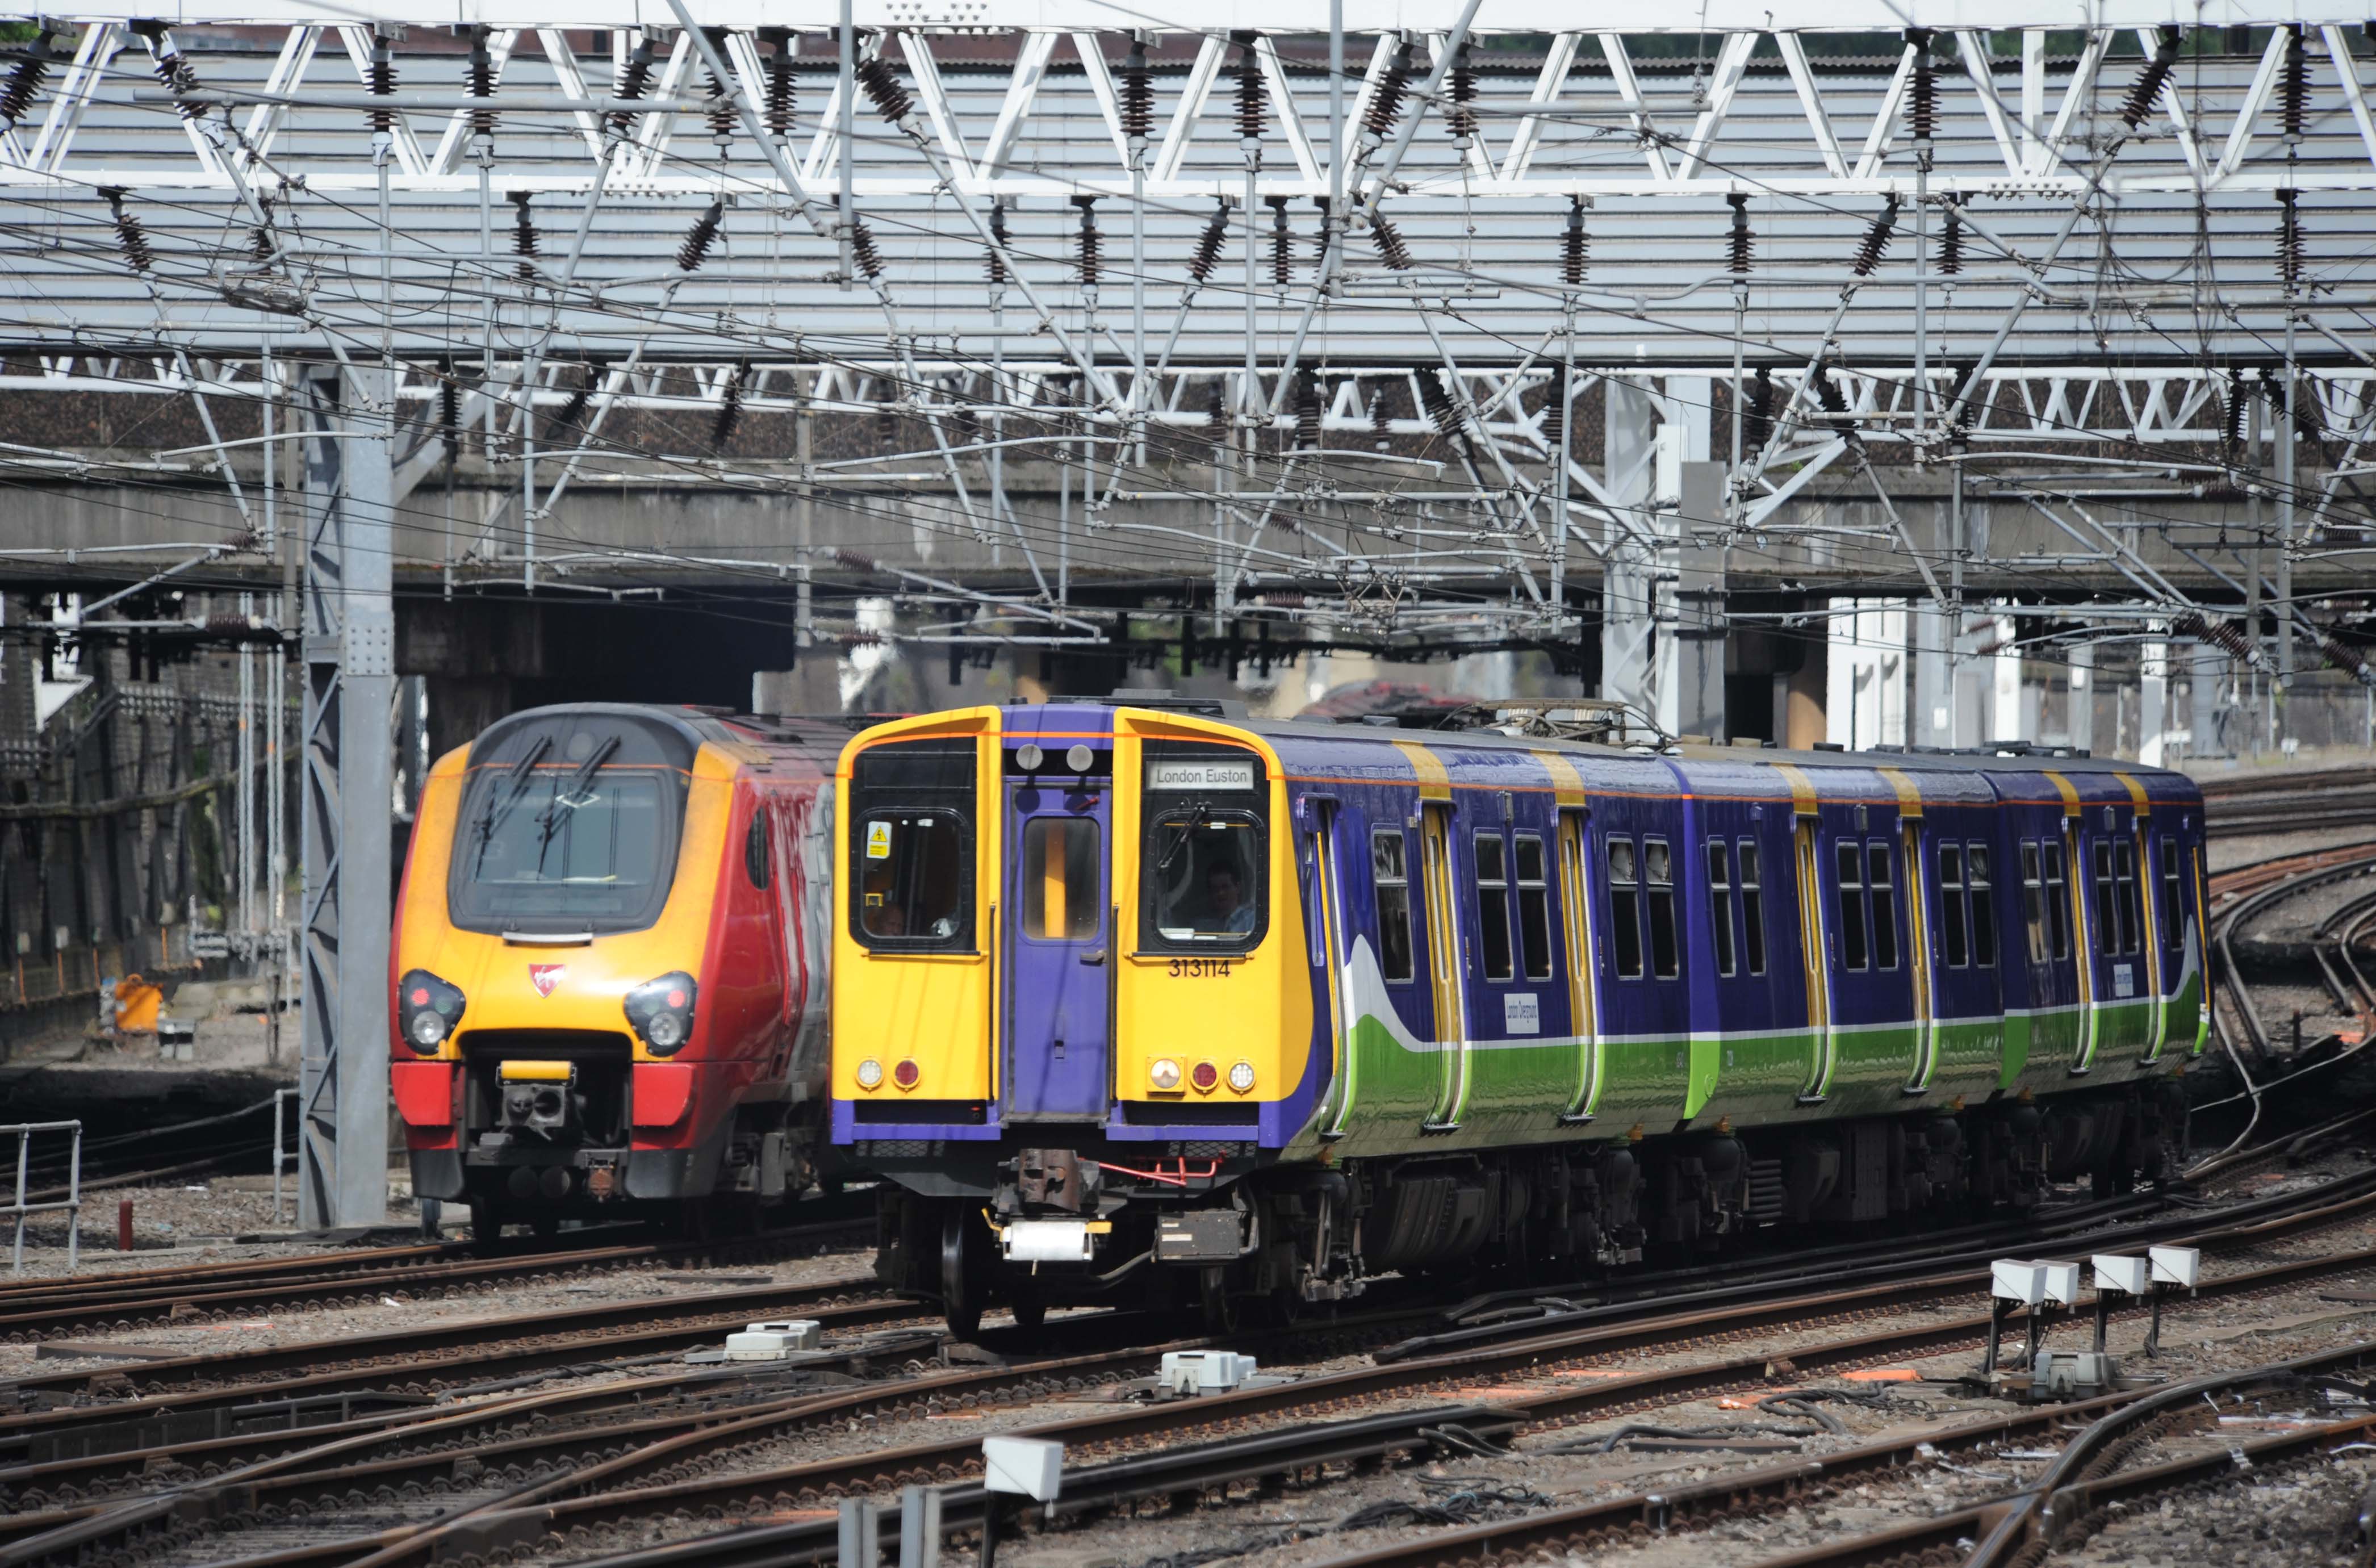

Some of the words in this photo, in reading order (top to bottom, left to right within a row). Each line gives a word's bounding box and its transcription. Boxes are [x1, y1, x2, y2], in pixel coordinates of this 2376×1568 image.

[1157, 768, 1202, 783] London
[1206, 768, 1247, 783] Euston
[1168, 959, 1231, 977] 313114
